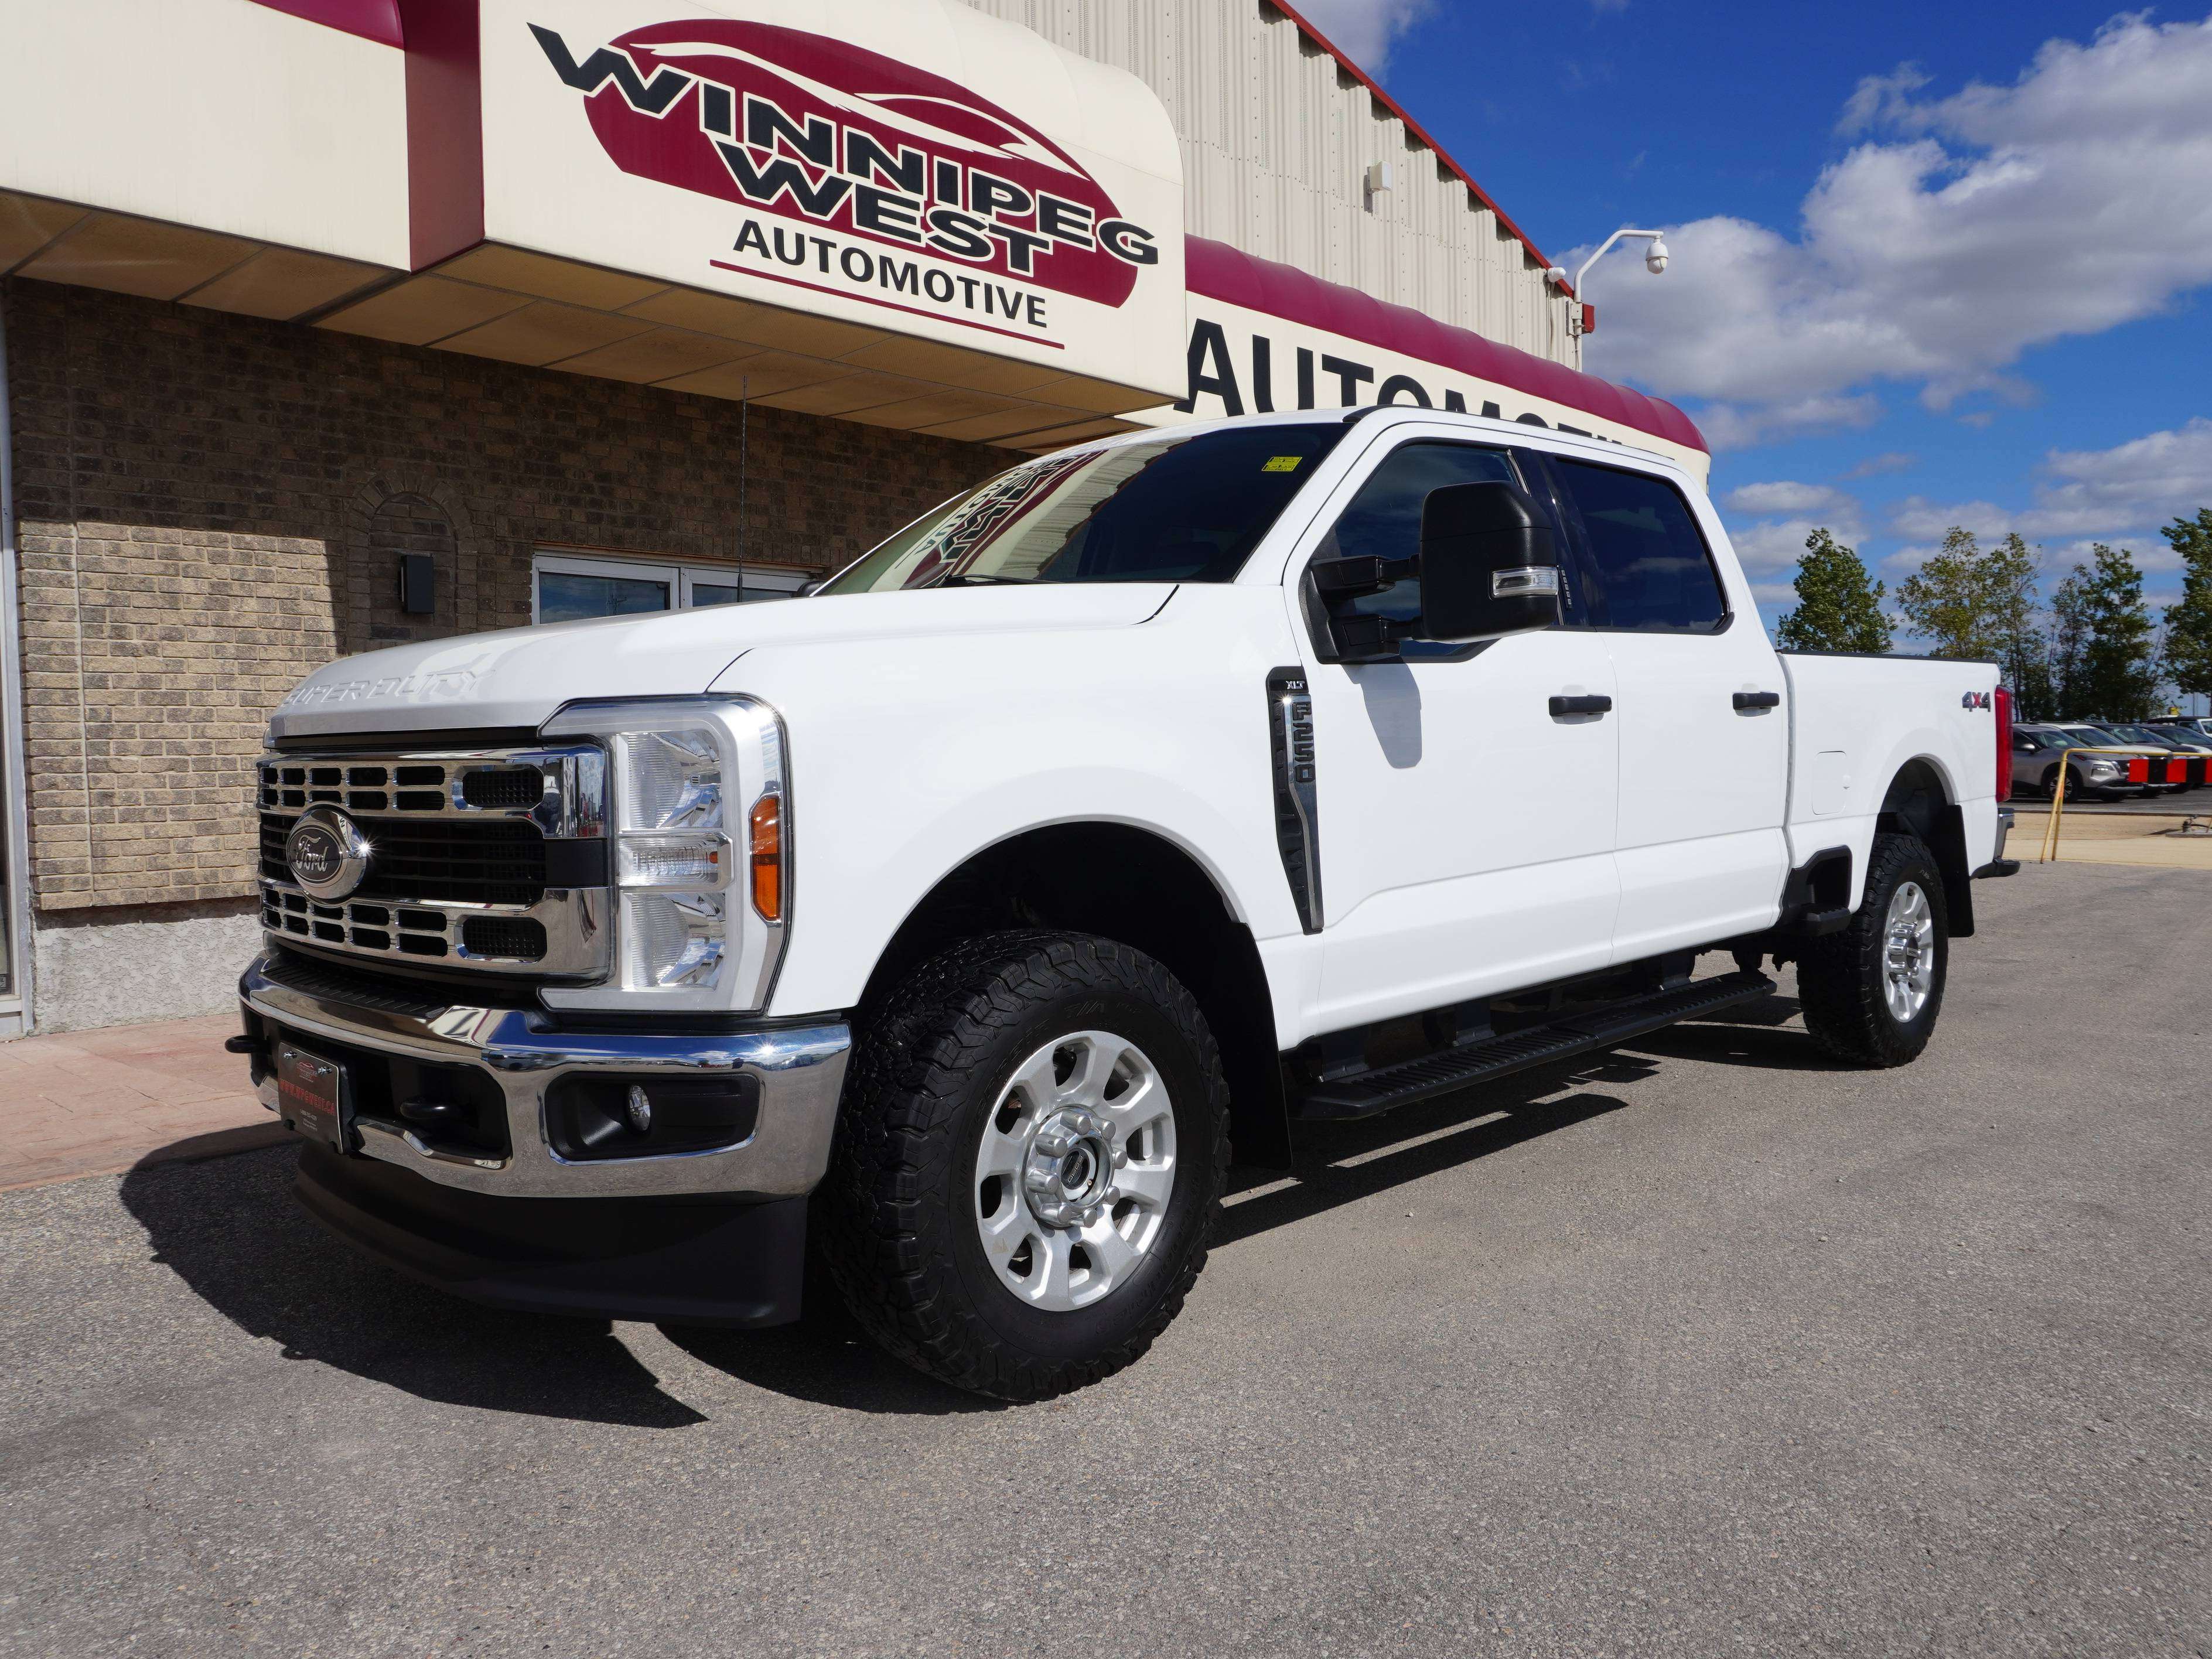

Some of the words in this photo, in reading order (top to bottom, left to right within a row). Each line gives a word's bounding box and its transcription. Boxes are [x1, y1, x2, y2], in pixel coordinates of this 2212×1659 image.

[526, 22, 1158, 265] WINNIPEG
[715, 142, 1053, 276] WEST
[733, 219, 1047, 328] AUTOMOTIVE
[1285, 680, 1305, 689] XLT
[1292, 702, 1315, 783] F250
[298, 834, 329, 872] Ford
